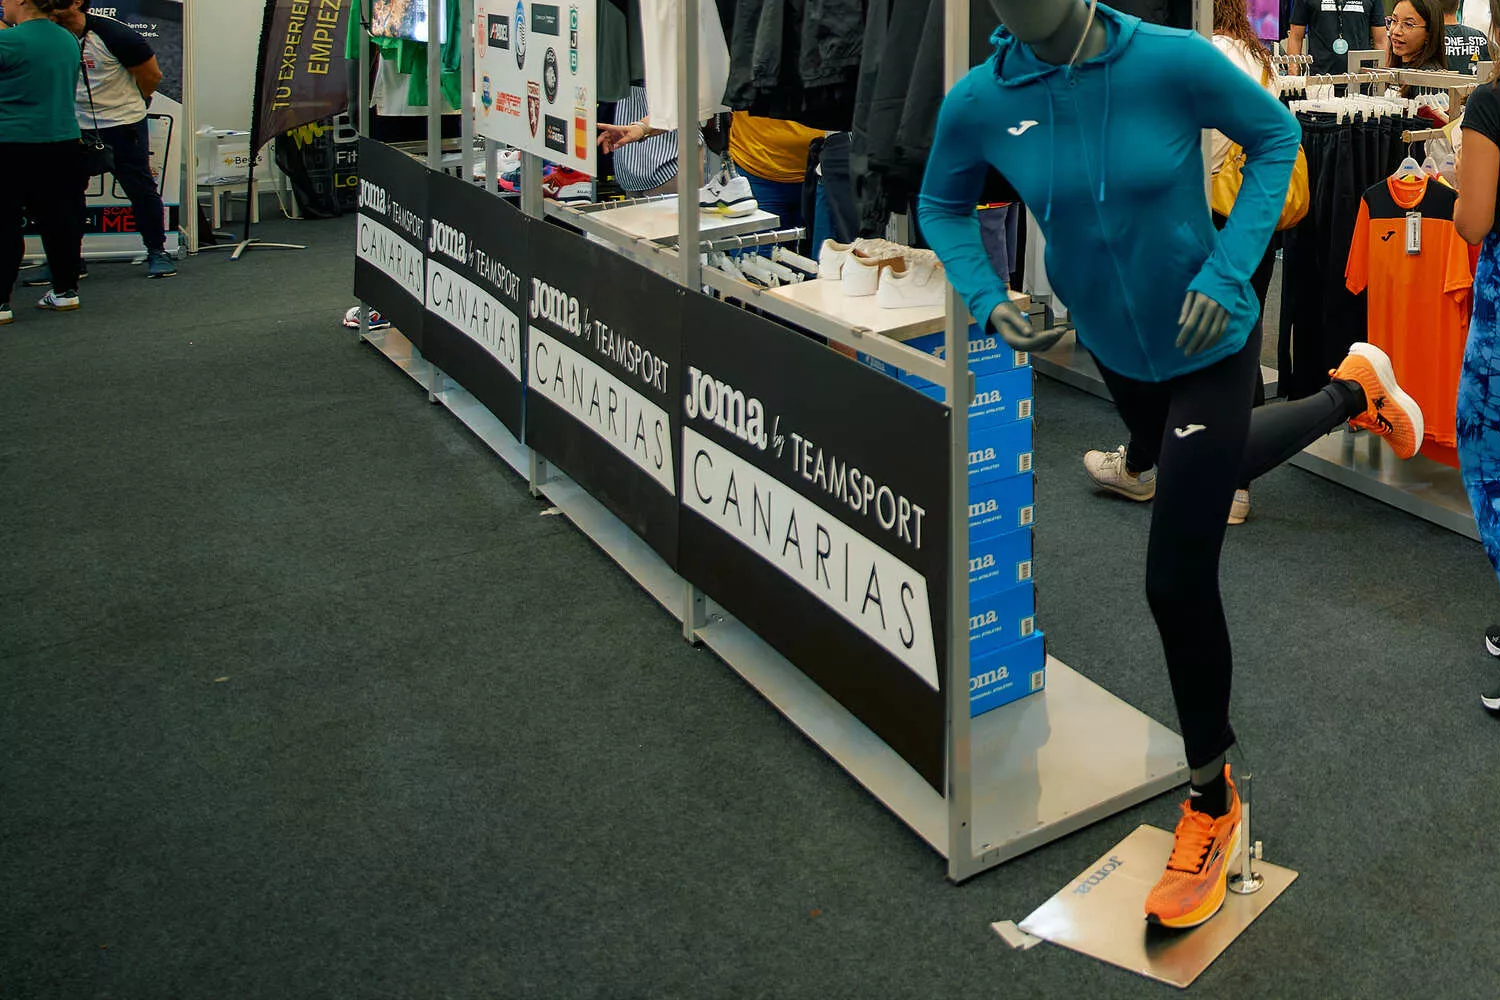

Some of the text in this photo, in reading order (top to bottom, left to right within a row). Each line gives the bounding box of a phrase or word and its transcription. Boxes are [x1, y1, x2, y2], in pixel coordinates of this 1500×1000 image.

[273, 88, 291, 111] TU
[103, 216, 136, 232] ME
[392, 201, 424, 241] TEAMSPORT
[361, 221, 422, 293] CANARIAS
[476, 250, 521, 302] TEAMSPORT
[432, 271, 517, 364] CANARIAS
[594, 319, 670, 394] TEAMSPORT
[968, 336, 998, 353] ma
[534, 341, 665, 471] CANARIAS
[968, 389, 1002, 407] ma
[968, 447, 997, 464] ma
[790, 432, 927, 550] TEAMSPORT
[968, 499, 998, 517] ma
[693, 448, 915, 650] CANARIAS
[969, 609, 998, 630] ma
[969, 664, 1010, 691] oma
